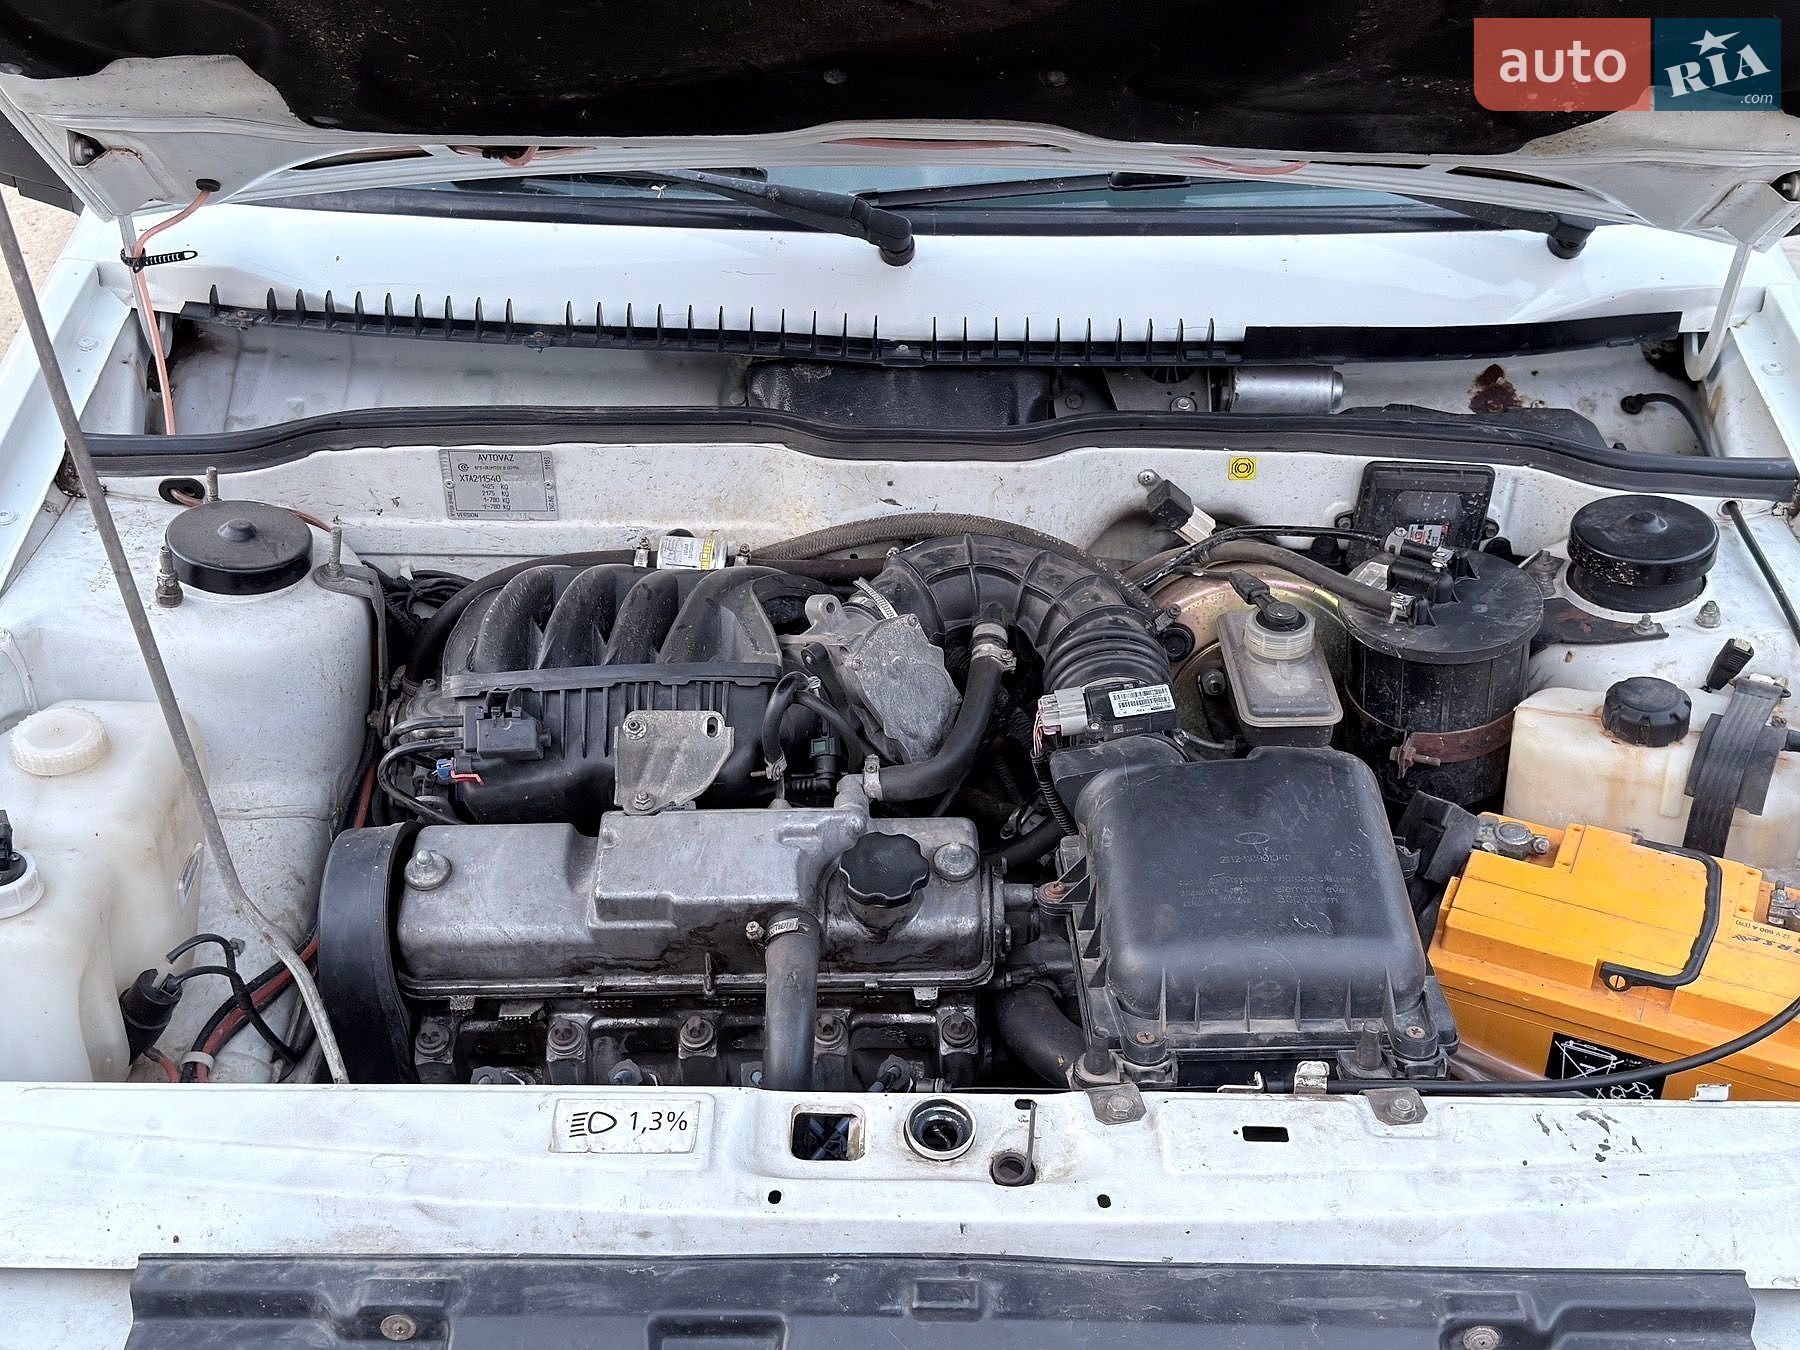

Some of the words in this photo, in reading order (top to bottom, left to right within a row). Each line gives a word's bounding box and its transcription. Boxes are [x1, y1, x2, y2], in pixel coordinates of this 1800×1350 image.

[478, 453, 514, 461] AVTOVAZ
[459, 474, 501, 482] XTA211540
[629, 1111, 688, 1134] 1,3%
